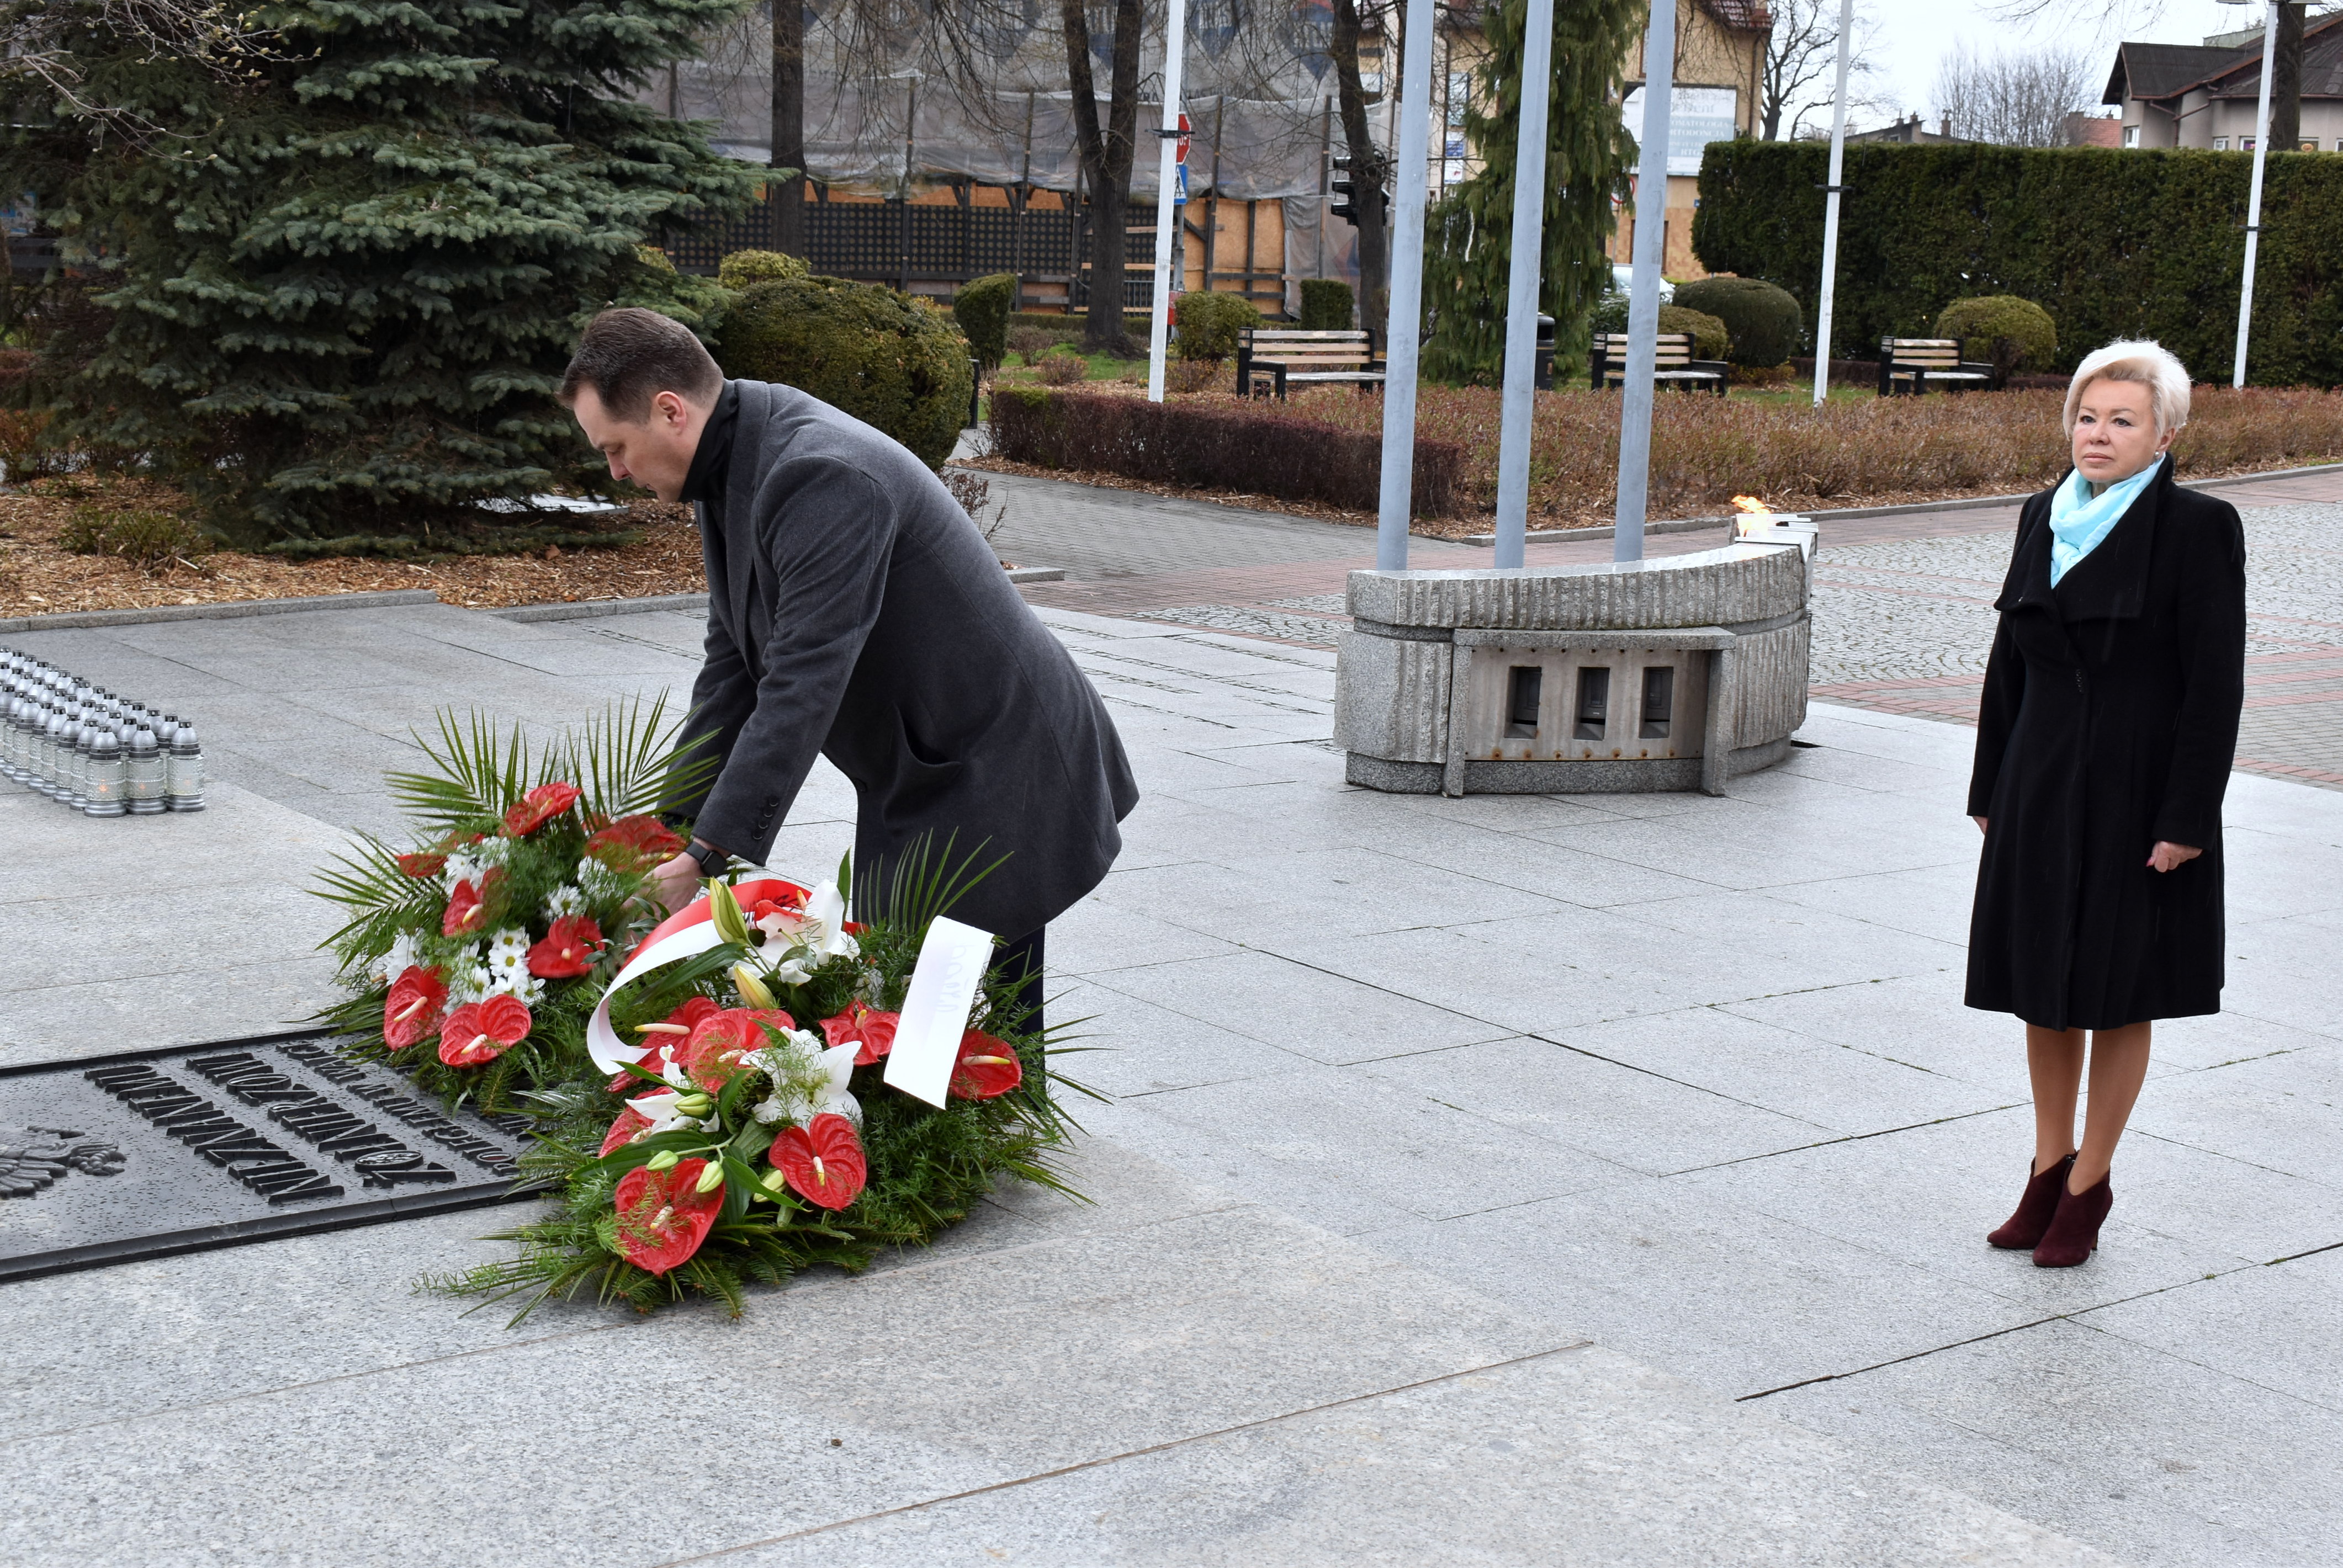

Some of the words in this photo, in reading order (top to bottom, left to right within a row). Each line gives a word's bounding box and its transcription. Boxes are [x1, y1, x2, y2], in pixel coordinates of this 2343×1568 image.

[1671, 119, 1729, 128] OMATOLOGIA
[1669, 128, 1725, 137] RTODONCJA
[346, 1083, 395, 1101] W
[84, 1065, 345, 1205] NIEZNANEMU
